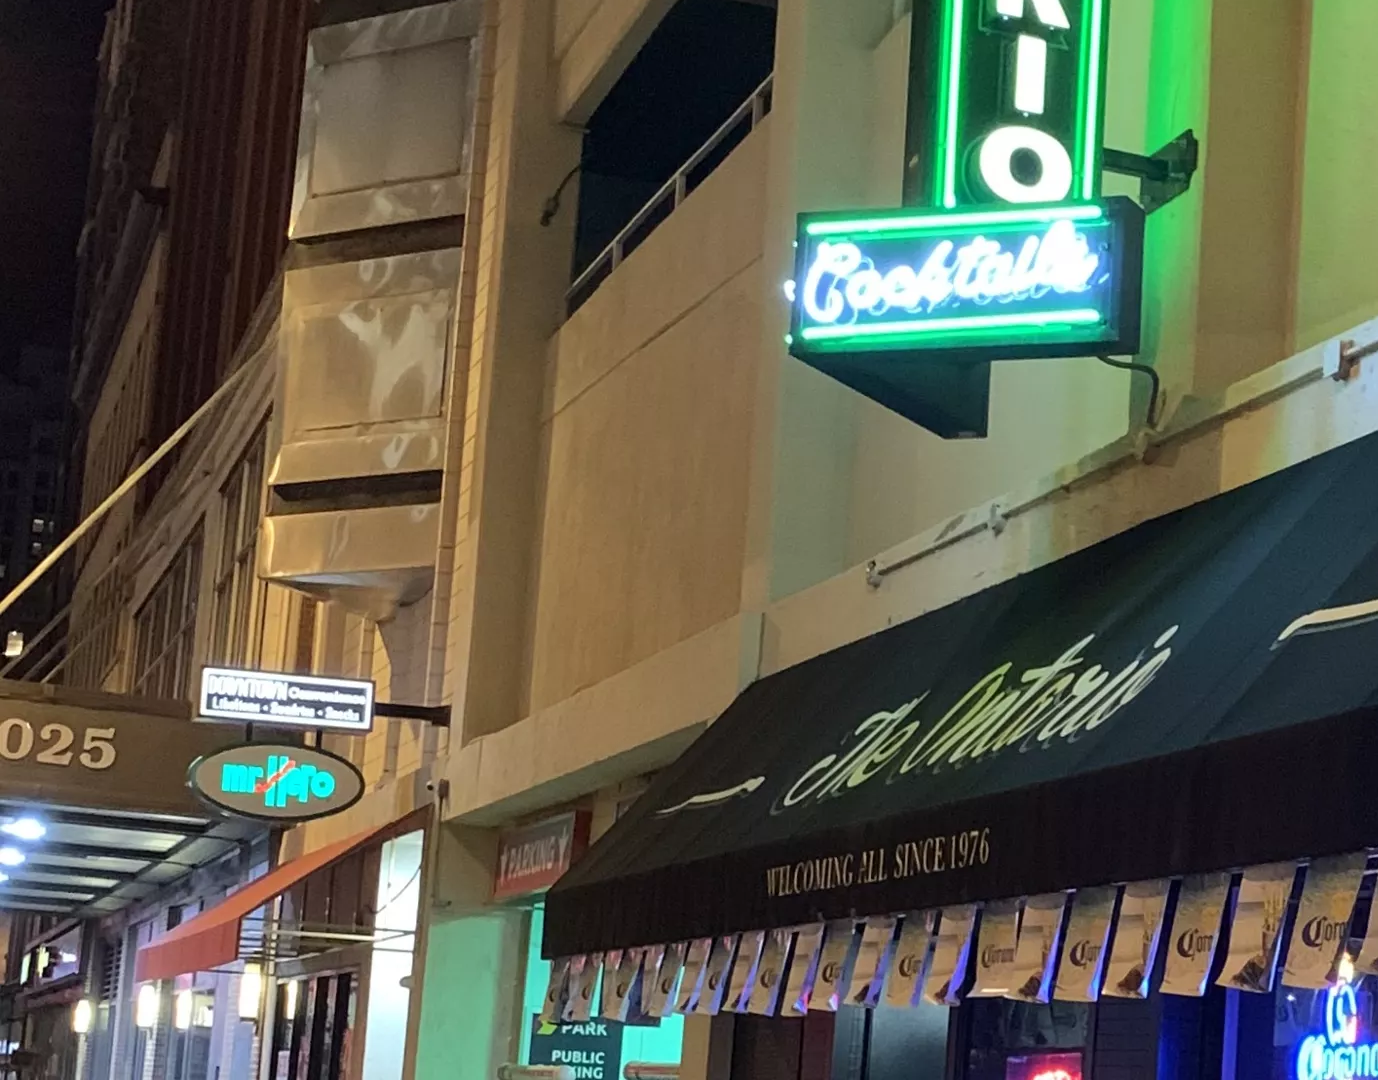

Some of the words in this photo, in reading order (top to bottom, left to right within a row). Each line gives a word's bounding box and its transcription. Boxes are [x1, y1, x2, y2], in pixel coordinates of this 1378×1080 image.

[803, 220, 1098, 323] Cocktails
[207, 676, 288, 702] DOWNTOWN
[784, 690, 931, 807] The
[900, 625, 1179, 774] Ontario
[506, 834, 556, 880] PARKING
[766, 854, 854, 899] WELCOMING
[857, 848, 887, 885] ALL
[893, 836, 946, 879] SINCE
[951, 827, 991, 870] 1976
[562, 1022, 607, 1036] PARK
[551, 1050, 605, 1064] PUBLIC
